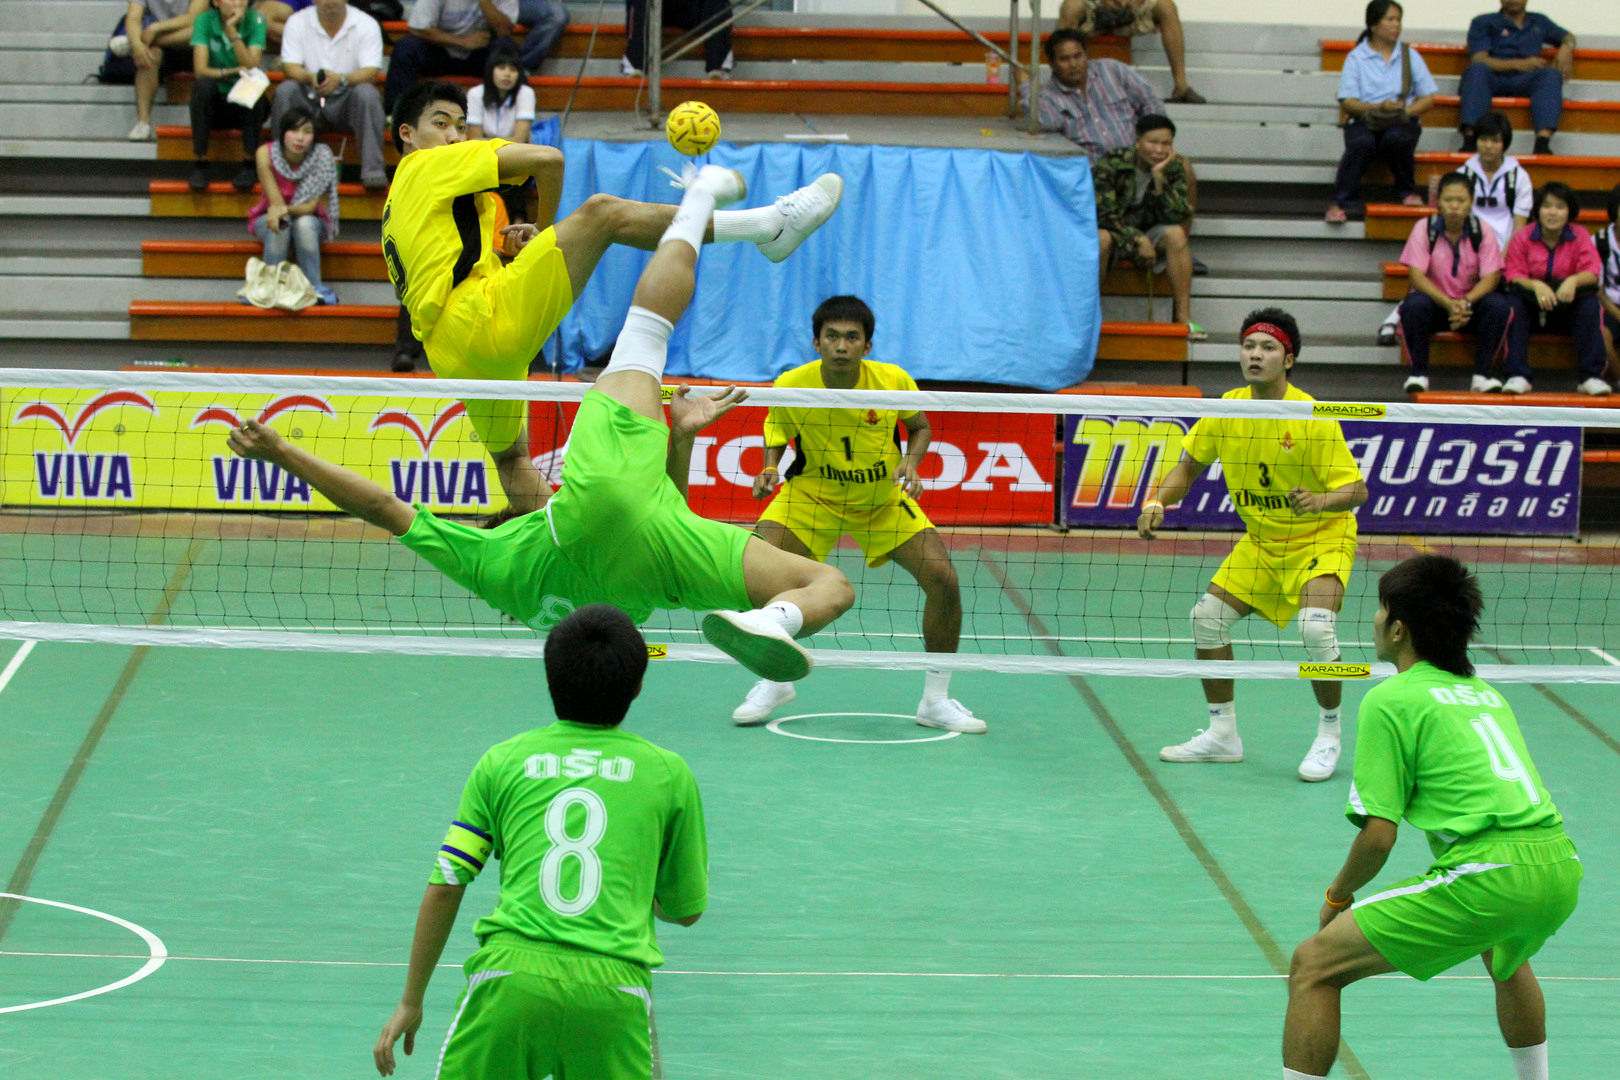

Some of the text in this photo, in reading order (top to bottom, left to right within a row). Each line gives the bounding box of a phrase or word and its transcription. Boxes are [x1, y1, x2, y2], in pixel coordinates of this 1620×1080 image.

[1313, 405, 1380, 414] MARATHON
[687, 434, 1053, 492] ODA
[840, 436, 851, 462] 1
[35, 452, 133, 499] VIVA
[212, 456, 311, 502] VIVA
[389, 459, 489, 505] VIVA
[1258, 462, 1270, 488] 3
[1299, 665, 1366, 674] MARATHON
[1468, 712, 1541, 806] 4
[538, 786, 609, 918] 8
